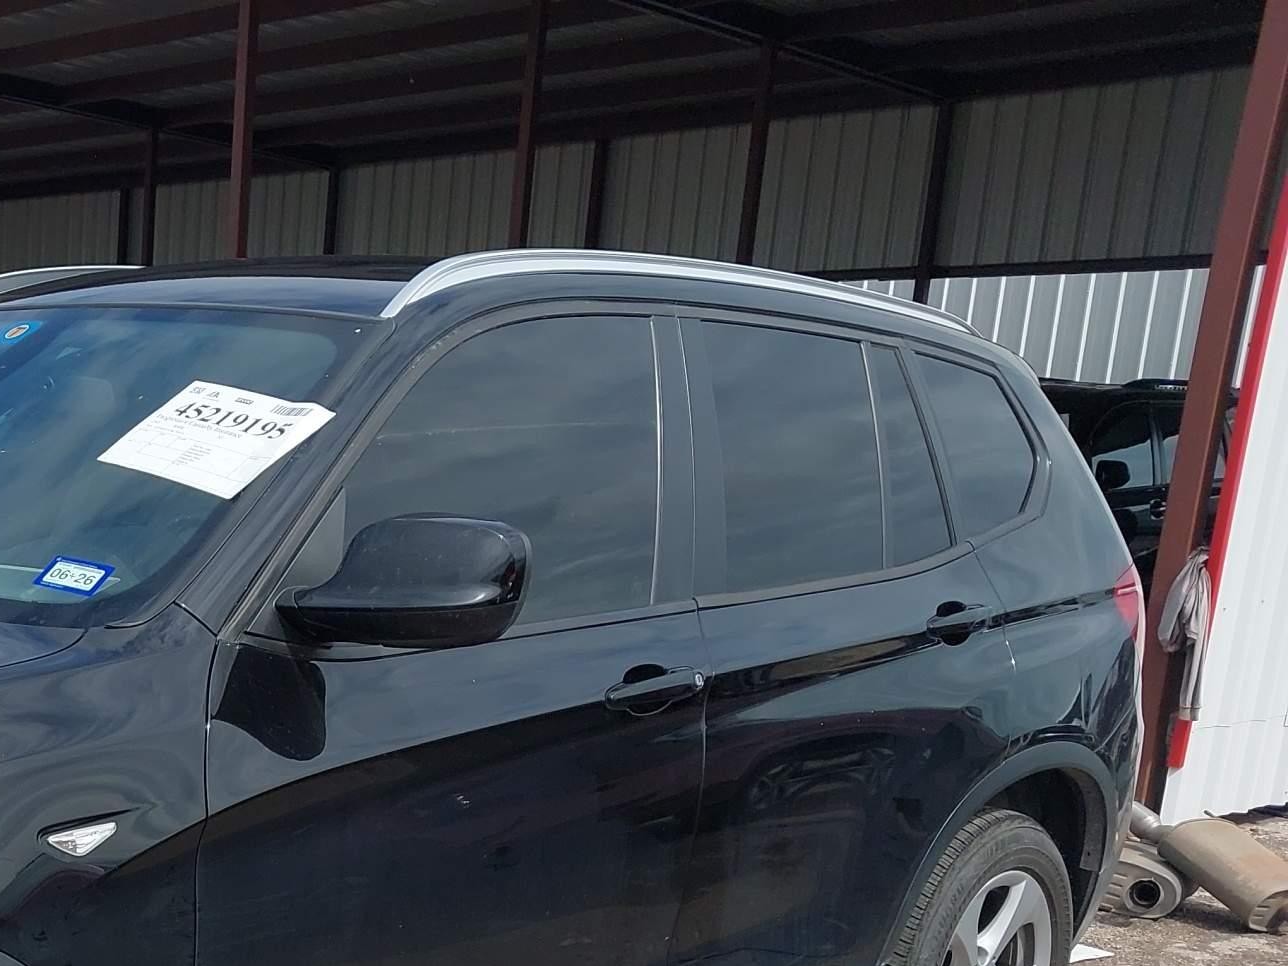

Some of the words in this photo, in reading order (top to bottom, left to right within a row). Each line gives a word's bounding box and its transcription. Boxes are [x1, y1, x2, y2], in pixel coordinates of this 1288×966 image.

[174, 402, 293, 439] 45219195
[49, 568, 70, 580] 06
[73, 573, 97, 586] 26
